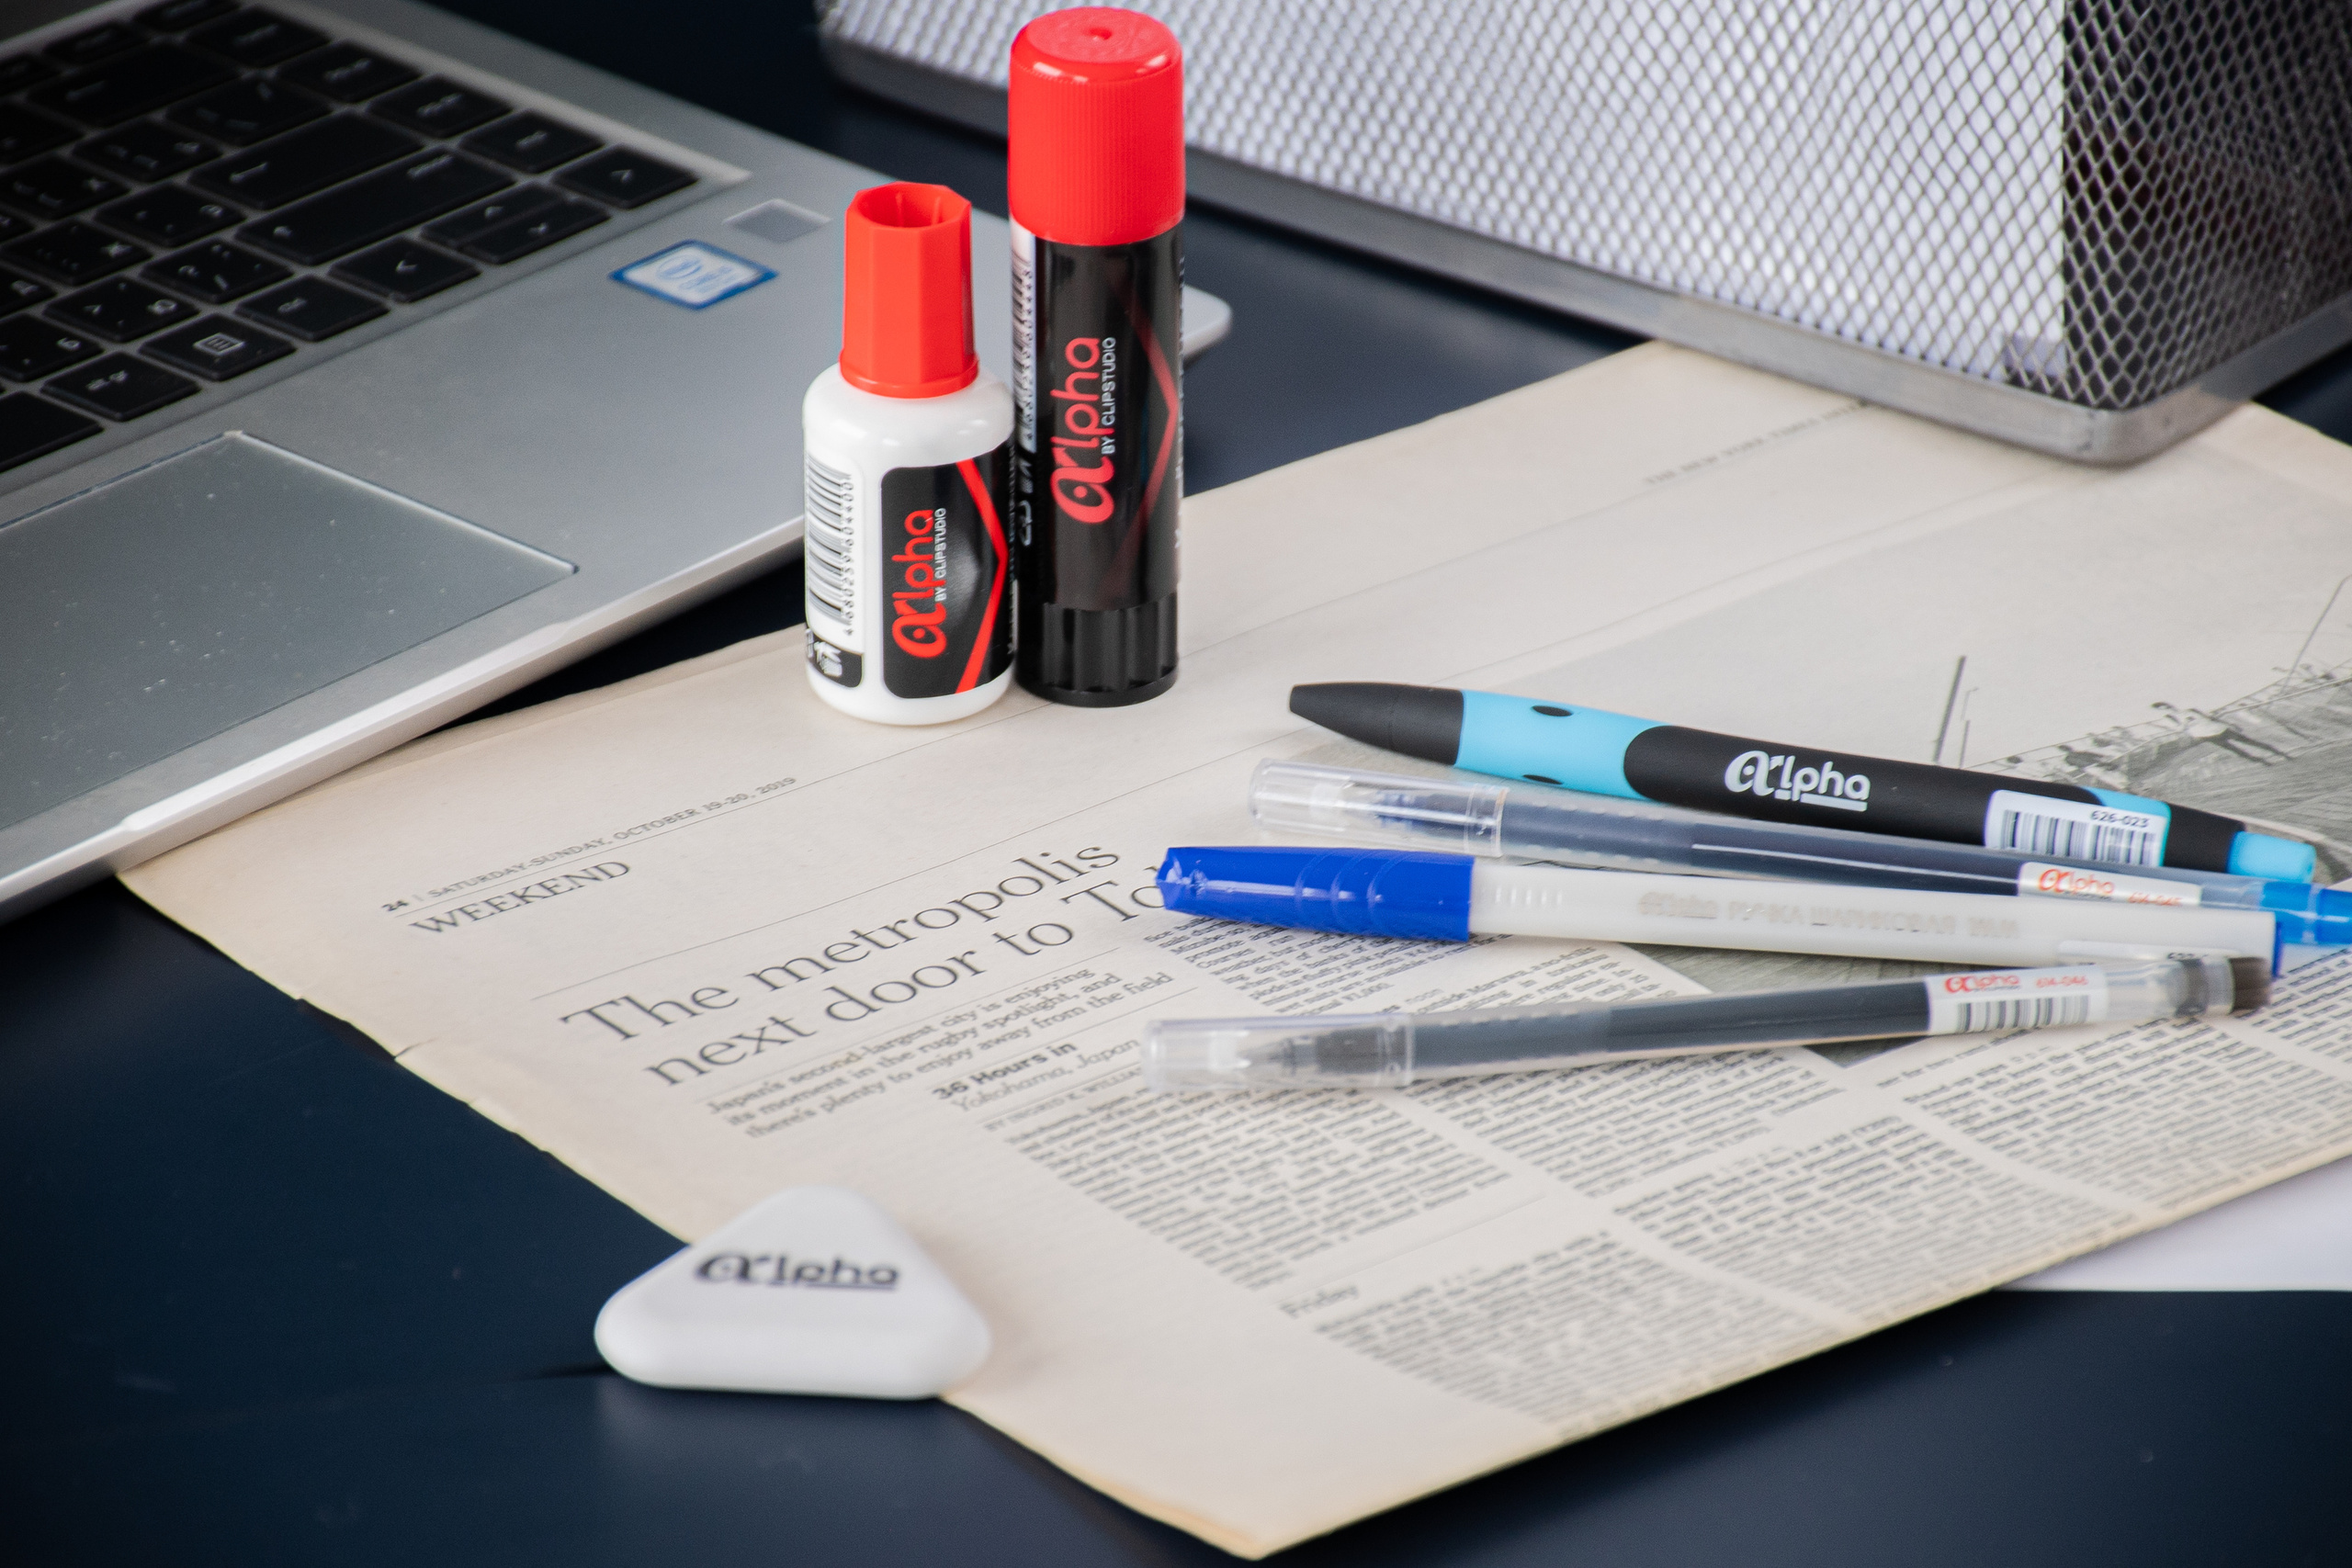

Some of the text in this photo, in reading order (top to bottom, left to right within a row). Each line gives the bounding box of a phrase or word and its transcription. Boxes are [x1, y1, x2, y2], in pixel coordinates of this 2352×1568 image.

[1101, 337, 1116, 454] BY CLIPSTUDIO
[933, 507, 947, 602] BY CLIPSTUDIO
[381, 777, 797, 913] 24 SATURDAY-SUNDAY, OCTOBER 19-20, 2019
[2089, 809, 2151, 829] 626-023
[408, 860, 631, 934] WEEKEND
[559, 845, 1121, 1042] The metropolis
[643, 866, 1165, 1087] next door to To
[788, 1026, 937, 1084] second-largest
[939, 1008, 981, 1029] city
[1004, 969, 1096, 1006] enjoying
[758, 1076, 847, 1117] moment
[875, 1046, 915, 1072] the
[916, 1024, 980, 1059] rugby
[980, 991, 1080, 1032] spotlight,
[1080, 974, 1124, 998] and
[819, 1078, 889, 1114] plenty
[916, 1045, 976, 1076] enjoy
[978, 1024, 1035, 1052] away
[1030, 1003, 1088, 1030] from
[1084, 989, 1124, 1013] the
[1120, 971, 1175, 1001] field
[930, 1041, 1080, 1101] 36 Hours in
[951, 1036, 1142, 1114] Yokohama, Japan
